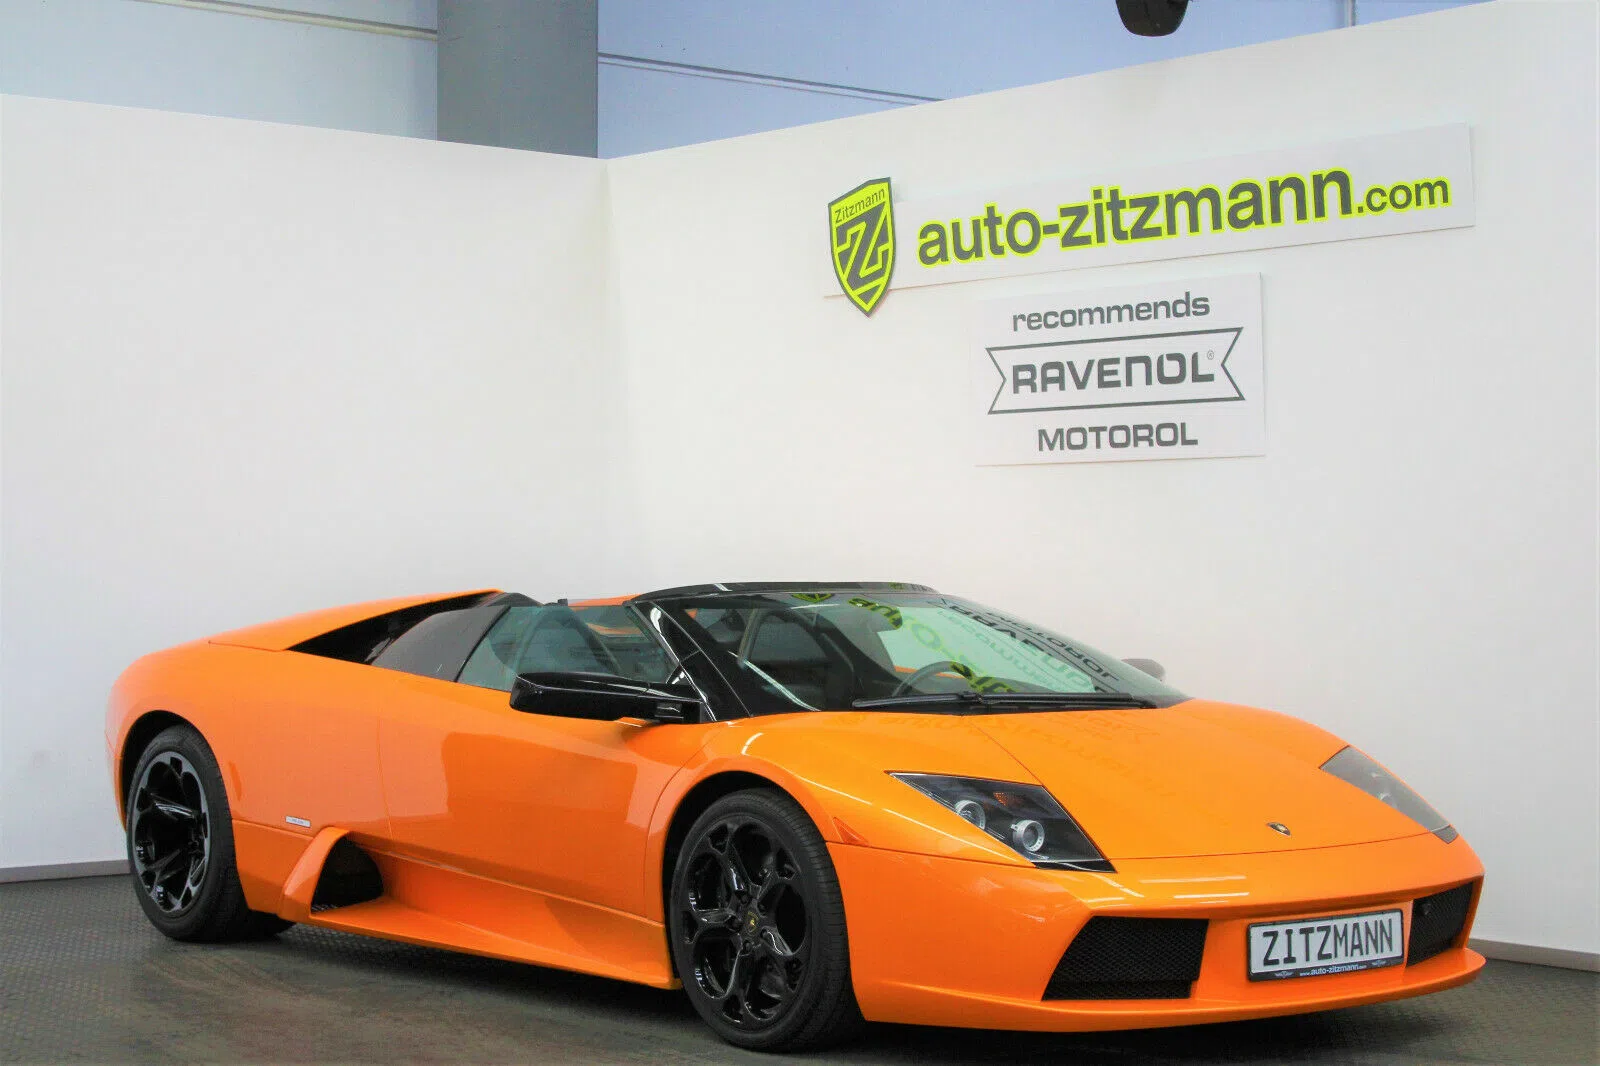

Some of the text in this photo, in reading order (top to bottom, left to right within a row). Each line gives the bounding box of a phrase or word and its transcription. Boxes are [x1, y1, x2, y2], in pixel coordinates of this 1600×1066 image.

[834, 188, 885, 223] Zitzmann
[918, 167, 1451, 268] auto-zitzmann.com
[1012, 291, 1211, 331] recommends
[1038, 422, 1199, 451] MOTOROL
[1262, 918, 1393, 967] ZITZMANN
